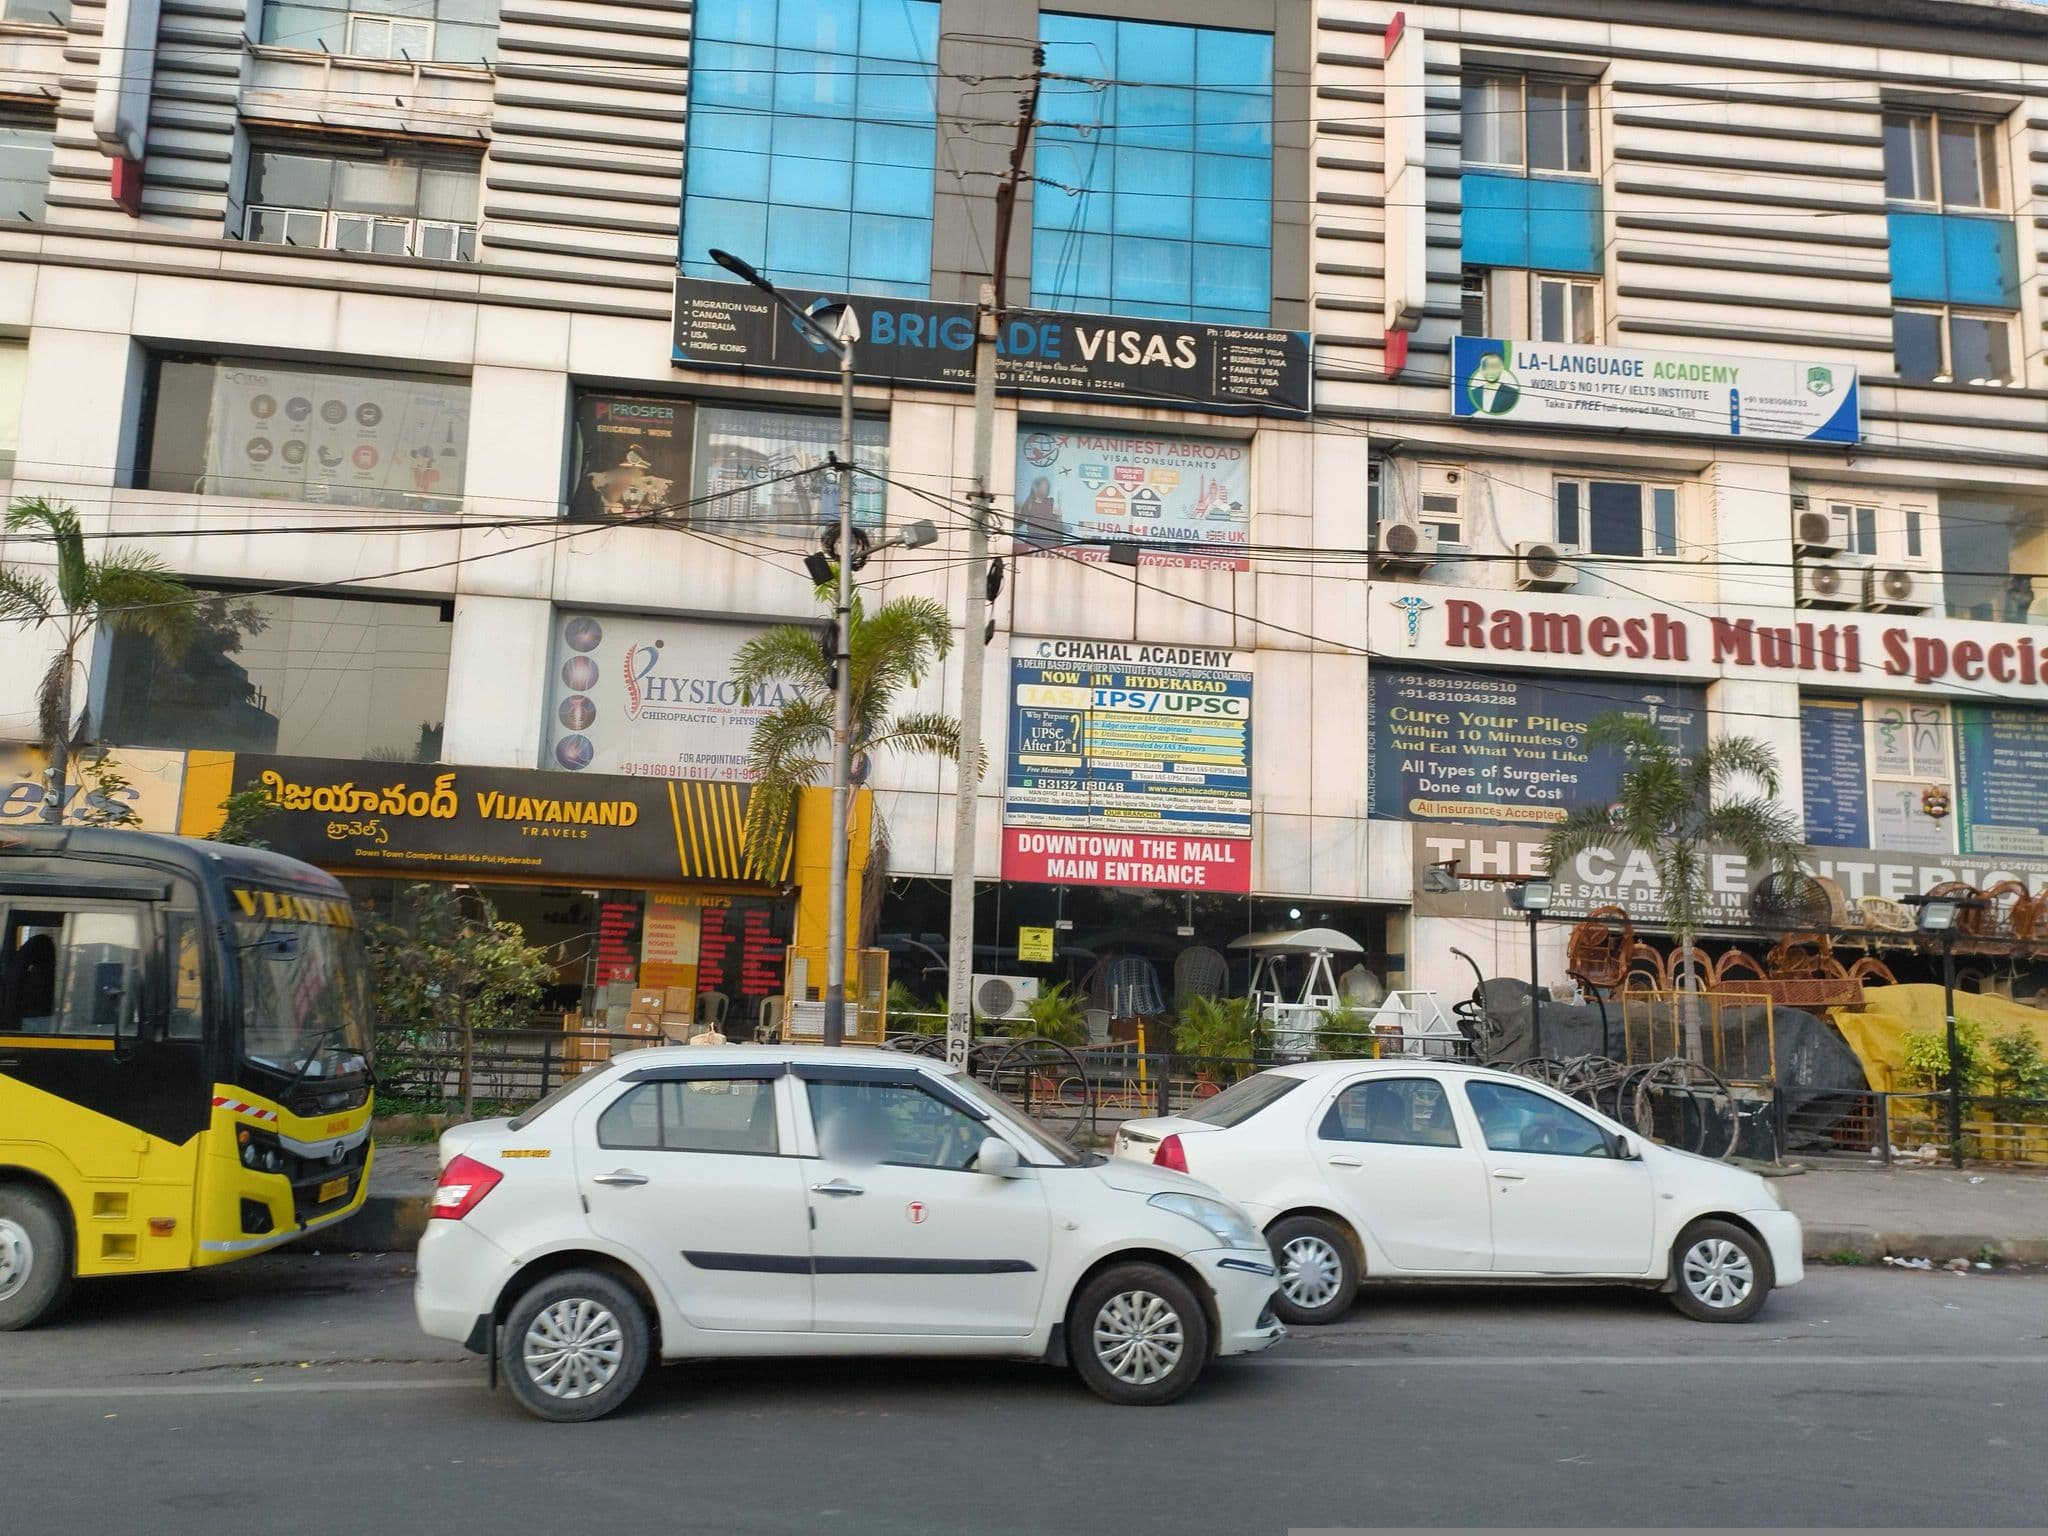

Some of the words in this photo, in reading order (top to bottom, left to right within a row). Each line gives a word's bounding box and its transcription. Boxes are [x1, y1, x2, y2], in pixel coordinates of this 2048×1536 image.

[691, 299, 742, 312] MIGRATION
[744, 304, 768, 314] VISAS
[691, 310, 731, 321] CANADA
[691, 320, 737, 332] AUSTRALIA
[691, 331, 708, 340] USA
[690, 341, 718, 351] HONG
[719, 344, 748, 353] KONG
[1075, 326, 1197, 370] VISAS
[1265, 348, 1285, 357] VISA
[1230, 355, 1267, 365] BUSINESS
[1267, 358, 1288, 367] VISA
[1518, 351, 1644, 379] LA-LANGUAGE
[1653, 360, 1740, 386] ACADEMY
[1230, 366, 1260, 375] FAMILY
[1260, 368, 1281, 377] VISA
[1230, 376, 1259, 385] TRAVEL
[1259, 378, 1280, 387] VISA
[1531, 378, 1576, 391] WORLD'S
[1578, 382, 1592, 392] NO
[1629, 385, 1657, 397] IELTS
[1658, 387, 1710, 401] INSTITUTE
[1250, 387, 1269, 396] VISA
[612, 403, 674, 419] PROSPER
[1544, 399, 1565, 409] Take
[1574, 399, 1601, 411] FREE
[1651, 407, 1675, 416] Mock
[1677, 409, 1696, 418] Test
[1076, 436, 1161, 456] MANIFEST
[1166, 442, 1241, 461] ABROAD
[1102, 454, 1129, 463] VISA
[1134, 456, 1217, 470] CONSULTANTS
[1097, 521, 1120, 534] USA
[1150, 525, 1200, 540] CANADA
[1228, 531, 1245, 543] UK
[1443, 597, 1690, 661] Ramesh
[1708, 616, 1860, 674] Multi
[1055, 641, 1132, 662] CHAHAL
[1139, 645, 1233, 668] ACADEMY
[1023, 660, 1046, 669] DELHI
[1047, 661, 1073, 671] BASED
[1108, 664, 1147, 676] INSTITUTE
[1147, 667, 1163, 676] FOR
[1212, 671, 1251, 681] COACHING
[1041, 671, 1080, 684] NOW
[1095, 674, 1113, 686] IN
[1125, 676, 1228, 693] HYDERABAD
[1397, 675, 1517, 693] +91-8919266510
[1397, 688, 1517, 706] +91-8310343288
[642, 711, 717, 724] CHIROPRACTIC
[1025, 711, 1041, 721] Why
[1389, 706, 1451, 726] Cure
[1459, 711, 1519, 729] Your
[1527, 715, 1589, 734] Piles
[1031, 727, 1065, 740] UPSC
[1389, 723, 1449, 740] Within
[1459, 728, 1482, 741] 10
[1488, 731, 1563, 747] Minutes
[1022, 739, 1051, 752] After
[1390, 739, 1426, 753] And
[1430, 742, 1459, 754] Eat
[1463, 743, 1508, 758] What
[1514, 747, 1546, 761] You
[1553, 750, 1589, 764] Like
[679, 752, 694, 763] FOR
[620, 763, 666, 777] +91-9160
[669, 765, 688, 778] 911
[690, 767, 707, 779] 611
[1026, 766, 1041, 774] Free
[1041, 768, 1074, 776] Mentorship
[1401, 760, 1425, 774] All
[1429, 762, 1476, 780] Types
[1481, 764, 1499, 779] of
[1504, 767, 1579, 785] Surgeries
[1038, 779, 1077, 791] 93132
[1148, 785, 1248, 798] www.chahalacademy.com
[1419, 779, 1461, 795] Done
[1466, 780, 1483, 795] at
[1487, 782, 1530, 798] Low
[1532, 785, 1563, 800] Cost
[476, 791, 639, 828] VIJAYANAND
[1417, 801, 1434, 814] All
[1437, 802, 1502, 817] Insurances
[1504, 804, 1563, 822] Accepted
[522, 826, 588, 839] TRAVELS
[355, 848, 380, 858] Down
[382, 849, 404, 859] Town
[405, 851, 442, 862] Complex
[444, 853, 467, 861] Lakdi
[1018, 833, 1135, 859] DOWNTOWN
[1140, 839, 1177, 860] THE
[1184, 843, 1236, 863] MALL
[1047, 858, 1099, 880] MAIN
[1105, 861, 1206, 885] ENTRANCE
[1425, 837, 1551, 877] THE
[1575, 846, 1749, 893] CAE
[695, 896, 732, 908] TRIPS
[1460, 879, 1494, 892] BIG
[1578, 883, 1629, 900] SALE
[1720, 893, 1742, 908] IN
